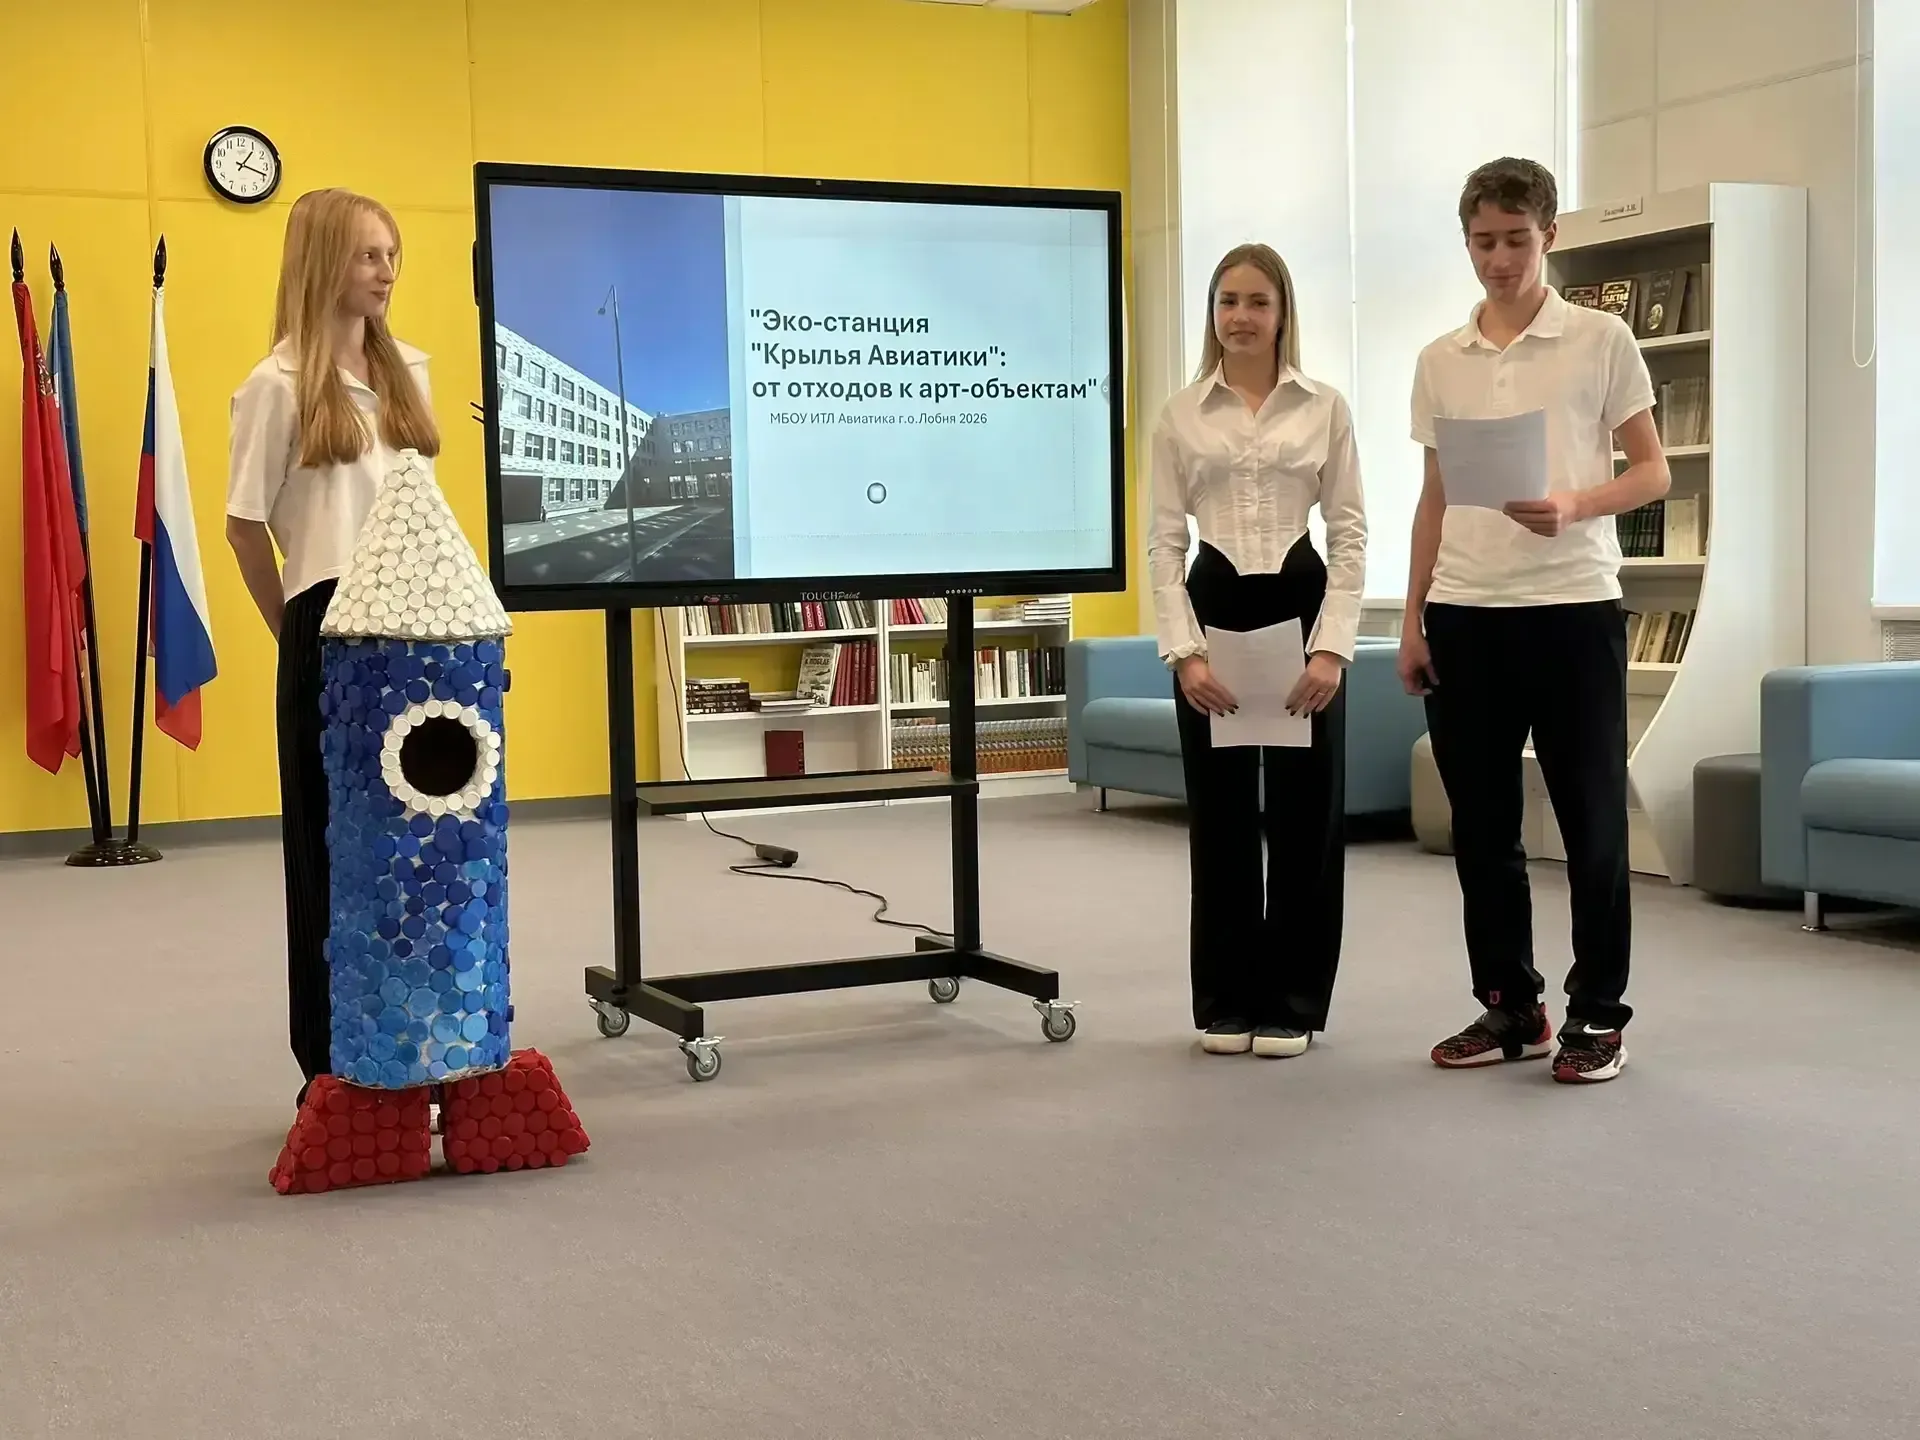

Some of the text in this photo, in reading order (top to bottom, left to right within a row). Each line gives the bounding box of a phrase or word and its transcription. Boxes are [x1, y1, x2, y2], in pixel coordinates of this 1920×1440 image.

[226, 140, 233, 149] 11
[237, 138, 245, 147] 12
[217, 148, 226, 157] 10
[259, 151, 265, 160] 2
[216, 160, 222, 168] 9
[262, 162, 269, 171] 3
[220, 172, 226, 180] 8
[229, 180, 234, 190] 7
[241, 184, 247, 193] 6
[252, 182, 258, 191] 5
[751, 309, 929, 336] "Эко-станция
[751, 343, 1006, 369] "Крылья Авиатики":
[752, 377, 1097, 403] от отходов к арт-объектам"
[770, 412, 807, 424] МБОУ
[811, 412, 834, 424] ИТЛ
[838, 412, 895, 425] Авиатика
[959, 412, 988, 424] 2026
